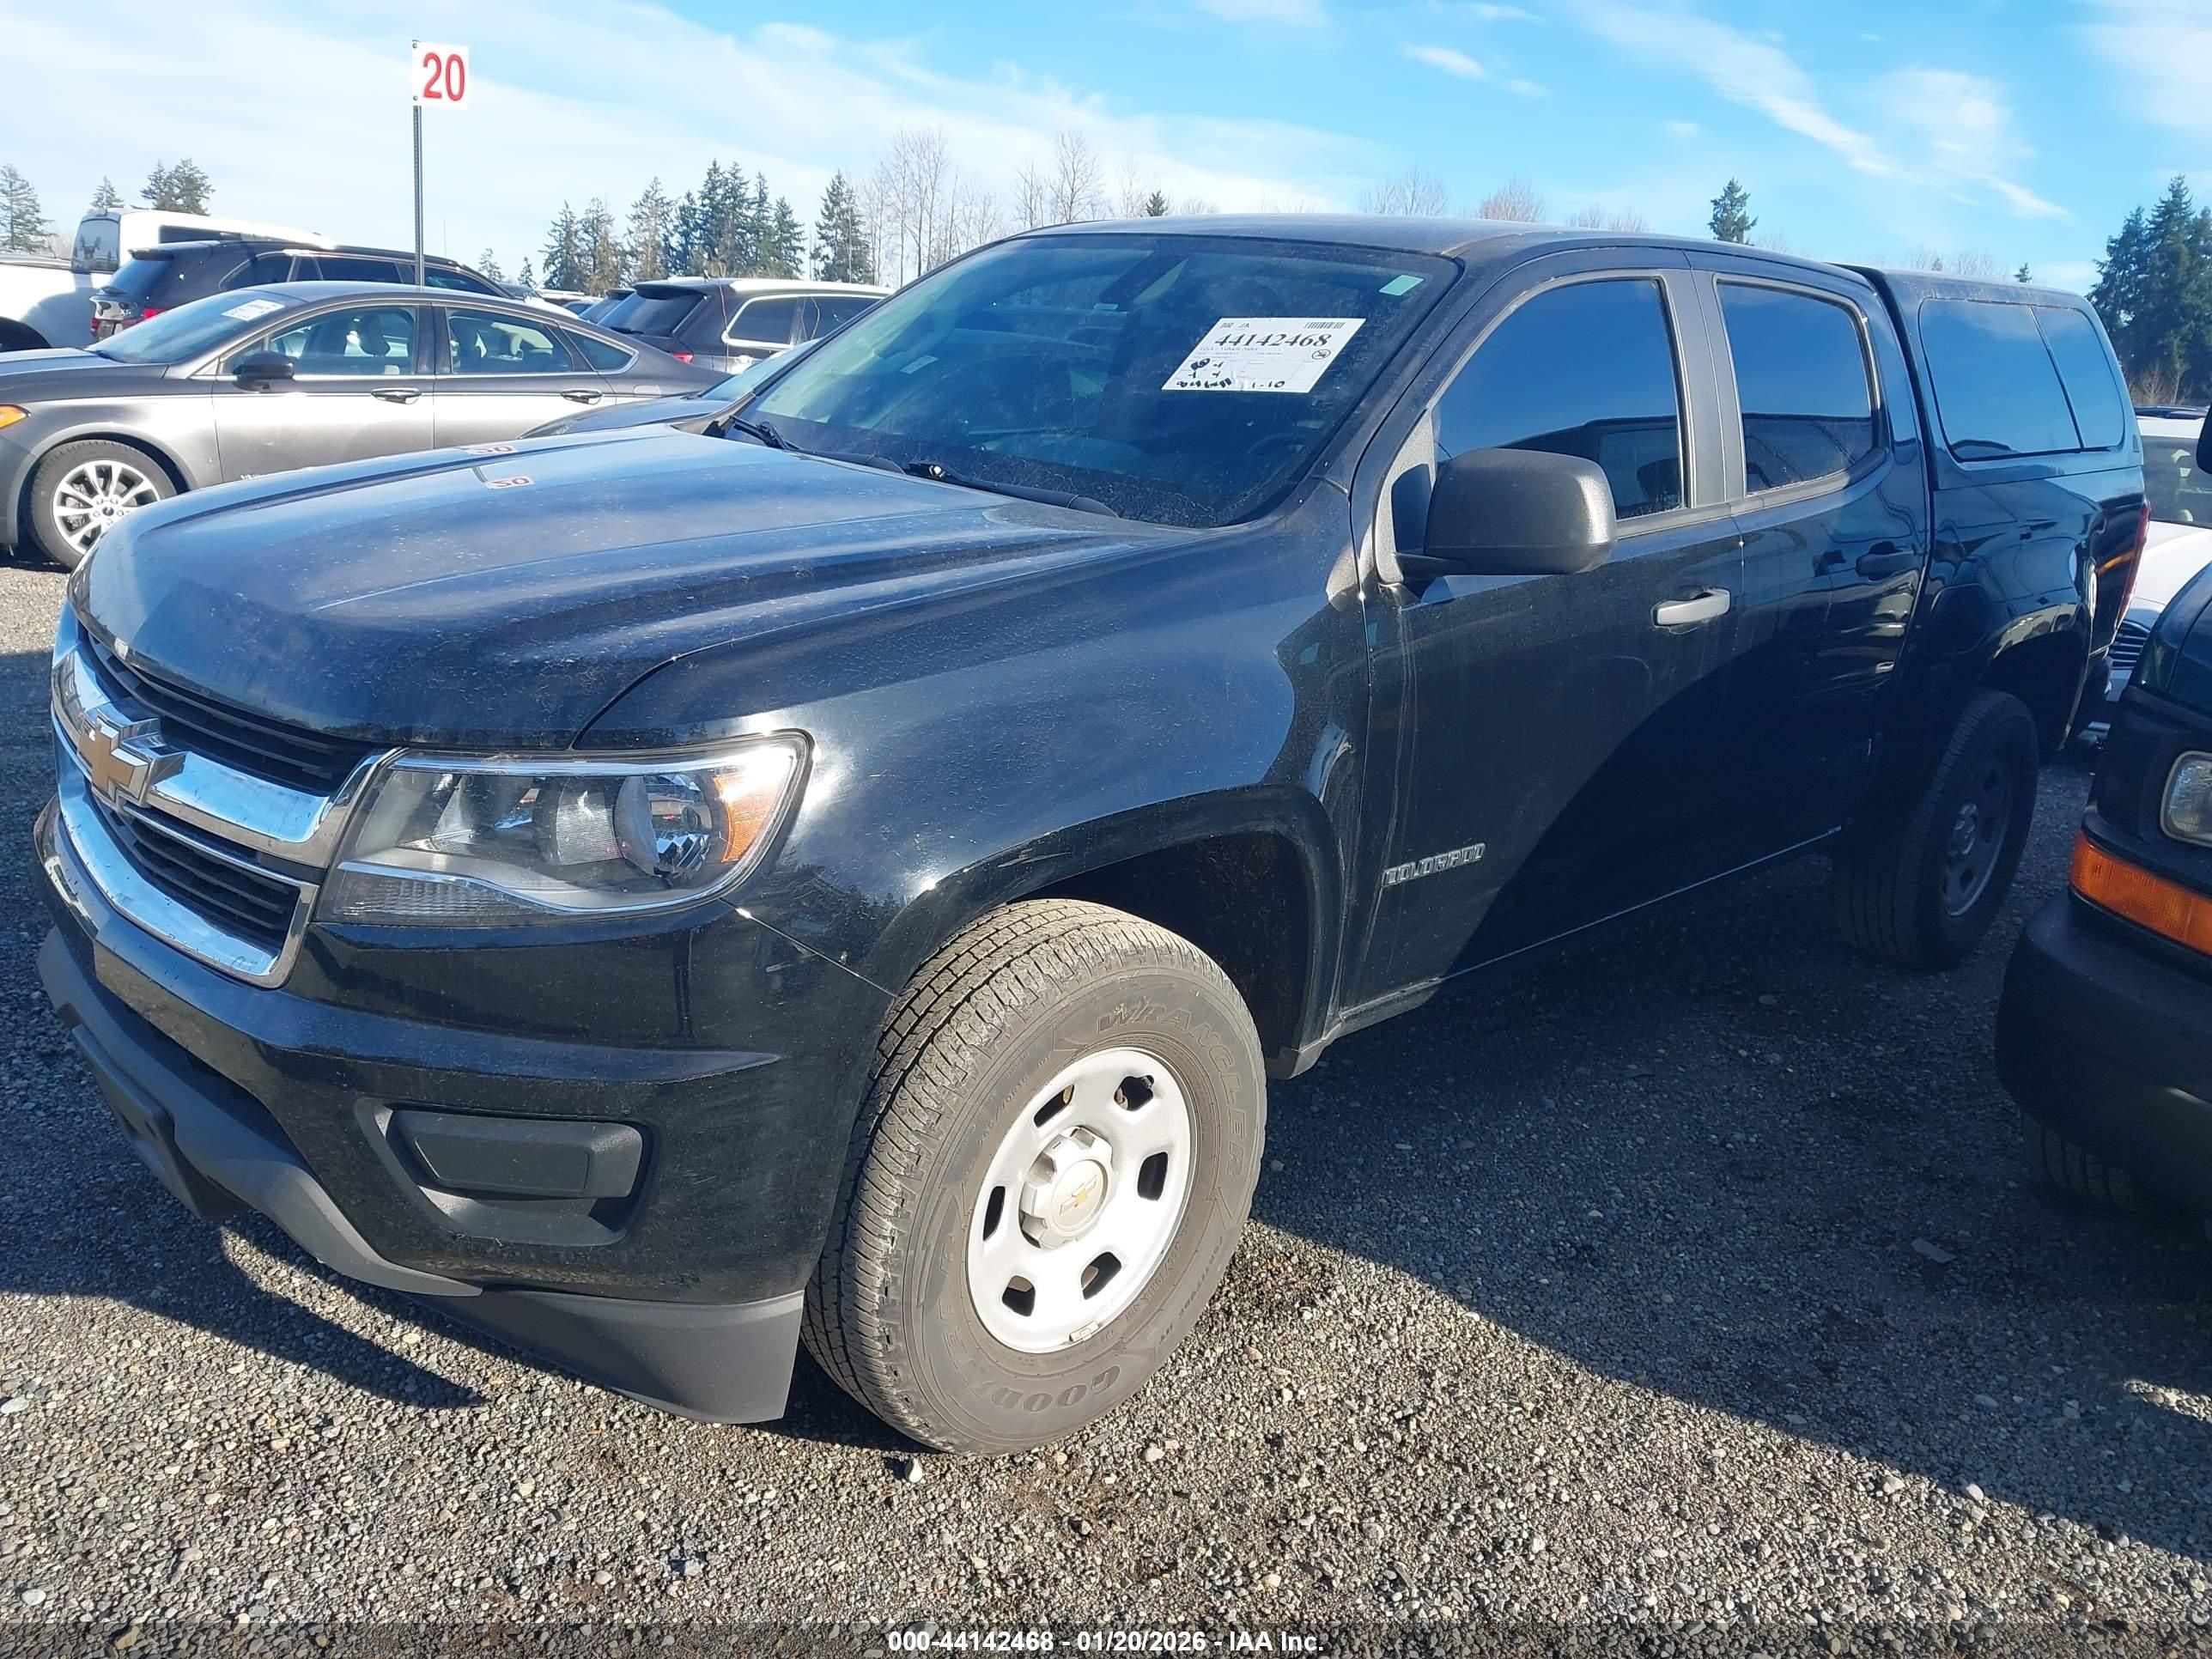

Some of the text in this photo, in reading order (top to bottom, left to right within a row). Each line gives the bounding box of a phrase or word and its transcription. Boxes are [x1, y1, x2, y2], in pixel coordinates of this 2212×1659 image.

[423, 52, 465, 101] 20
[1215, 332, 1333, 347] 44142468
[1382, 842, 1486, 886] COLORADO
[1098, 998, 1245, 1177] WRANGLER
